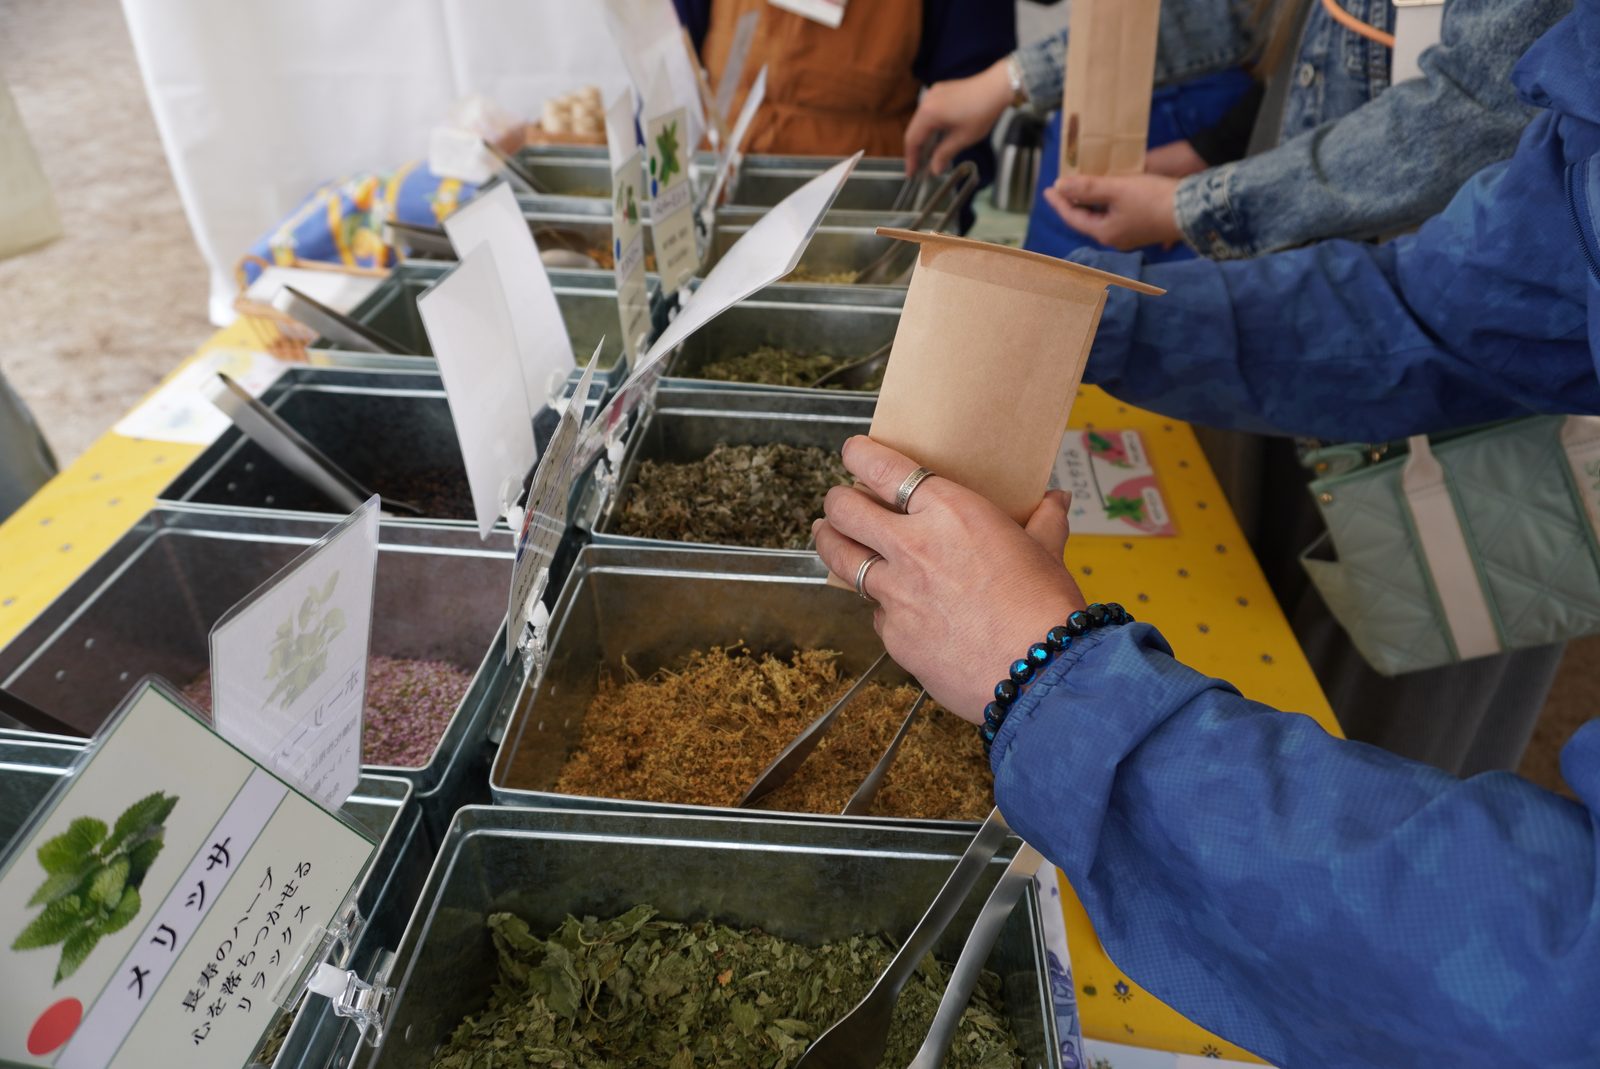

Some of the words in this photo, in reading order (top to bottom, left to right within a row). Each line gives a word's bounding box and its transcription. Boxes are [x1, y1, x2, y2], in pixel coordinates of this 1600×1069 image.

[127, 836, 232, 1000] メリッサ
[181, 865, 273, 1013] 長寿のハーブ
[191, 860, 312, 1046] 心を落ちつかせる
[236, 903, 311, 1013] リラックス
